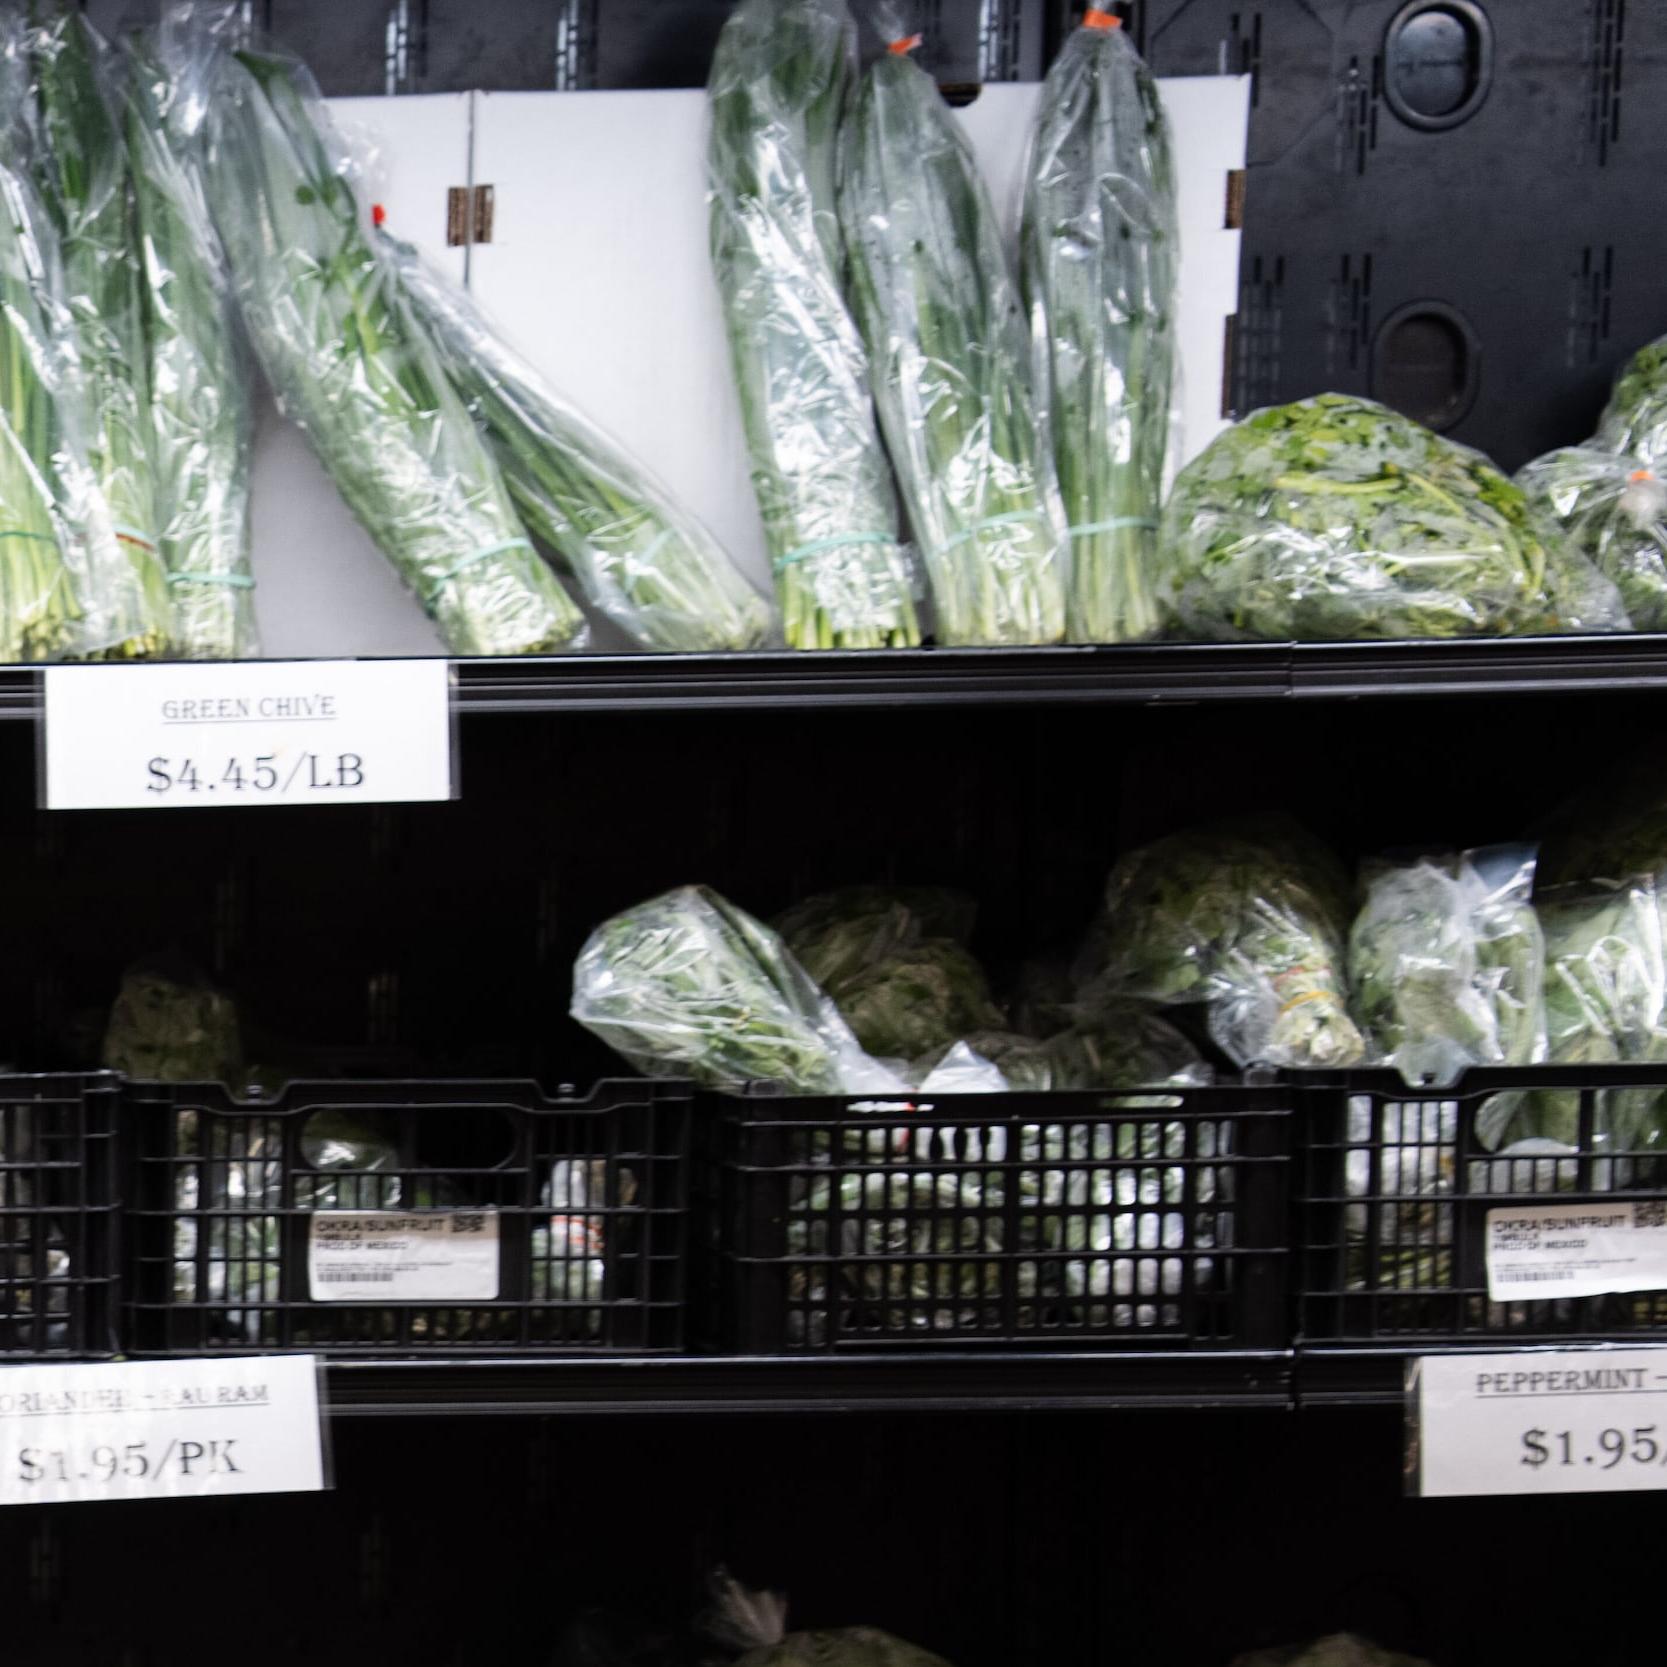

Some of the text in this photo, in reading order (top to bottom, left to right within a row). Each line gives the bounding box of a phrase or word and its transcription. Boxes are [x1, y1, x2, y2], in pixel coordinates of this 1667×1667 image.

[161, 694, 337, 720] GREEN CHIVE
[146, 751, 367, 795] $4.45/LB
[217, 1383, 271, 1403] RAM
[1476, 1368, 1649, 1393] PEPPERMINT
[19, 1438, 244, 1485] $1.95/PK
